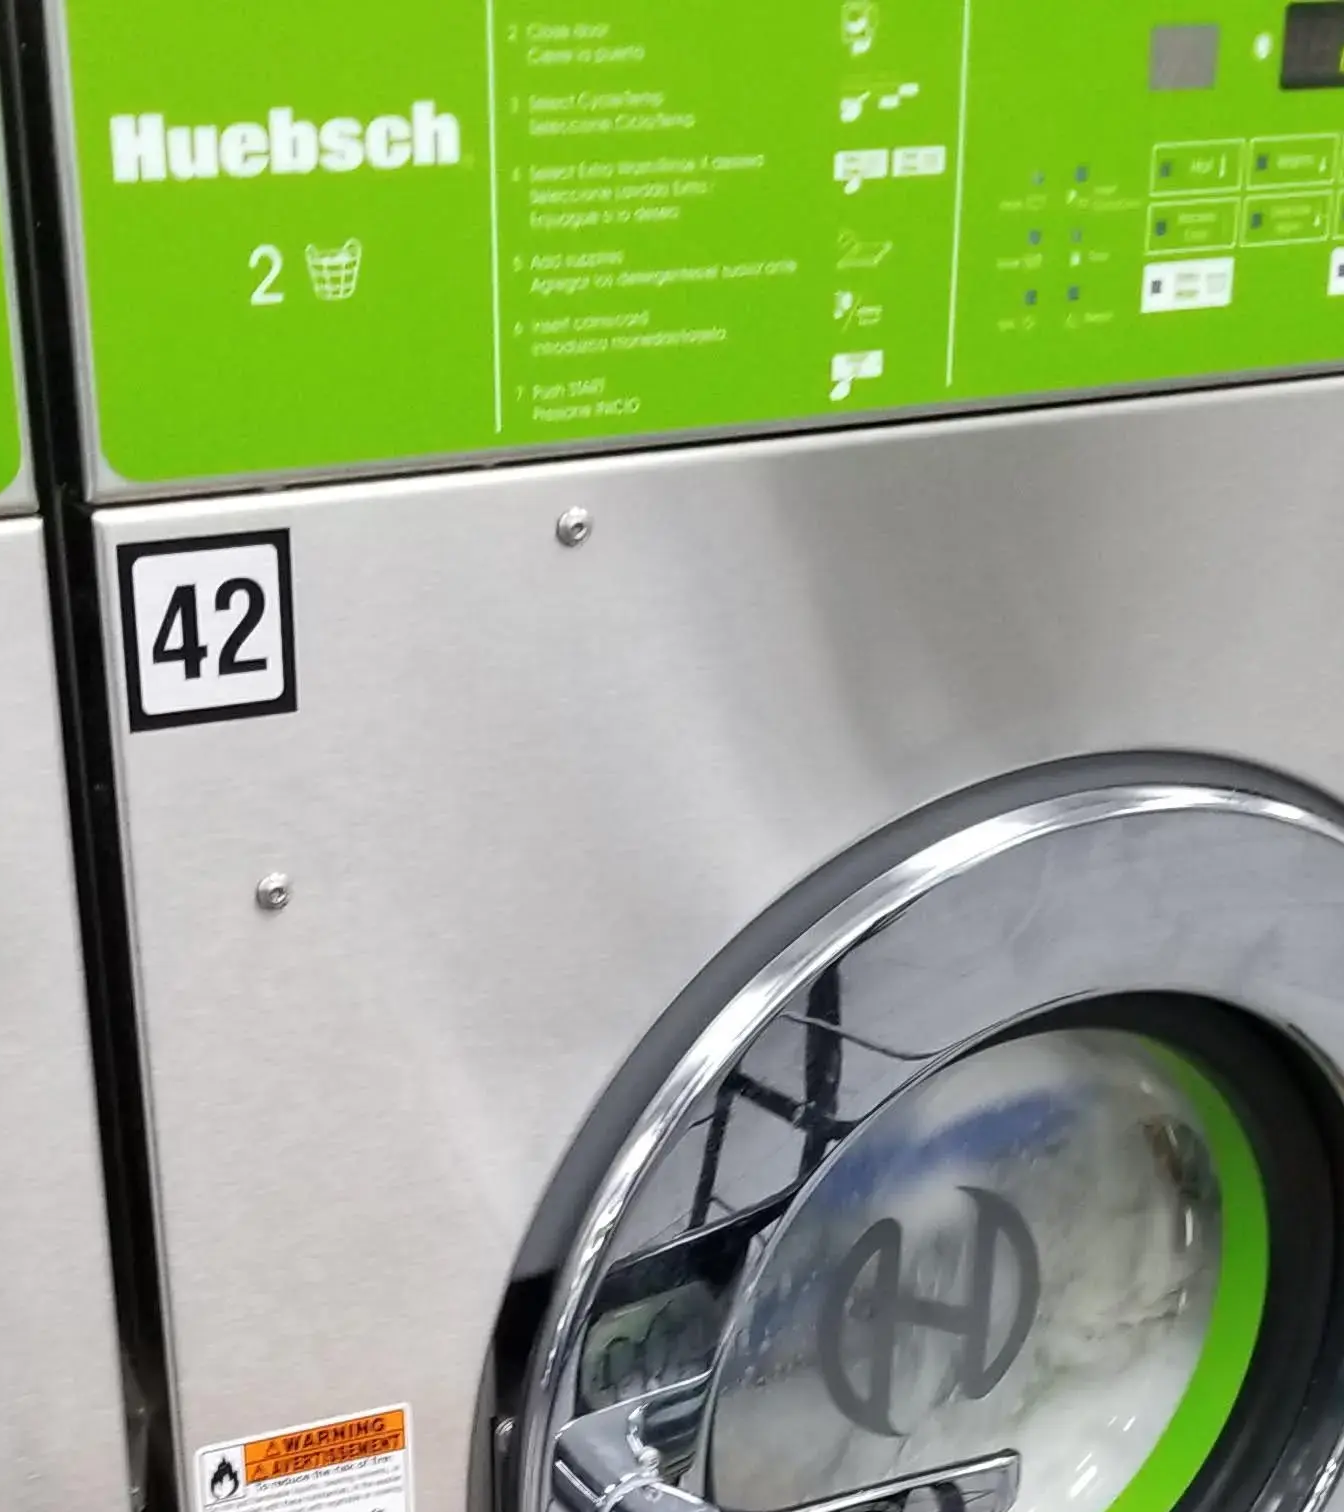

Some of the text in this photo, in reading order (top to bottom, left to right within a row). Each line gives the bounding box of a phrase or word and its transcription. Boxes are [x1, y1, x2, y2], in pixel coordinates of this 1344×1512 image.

[109, 99, 460, 184] Huebsch
[247, 243, 285, 306] 2
[153, 577, 268, 681] 42
[283, 1416, 385, 1452] WARNING
